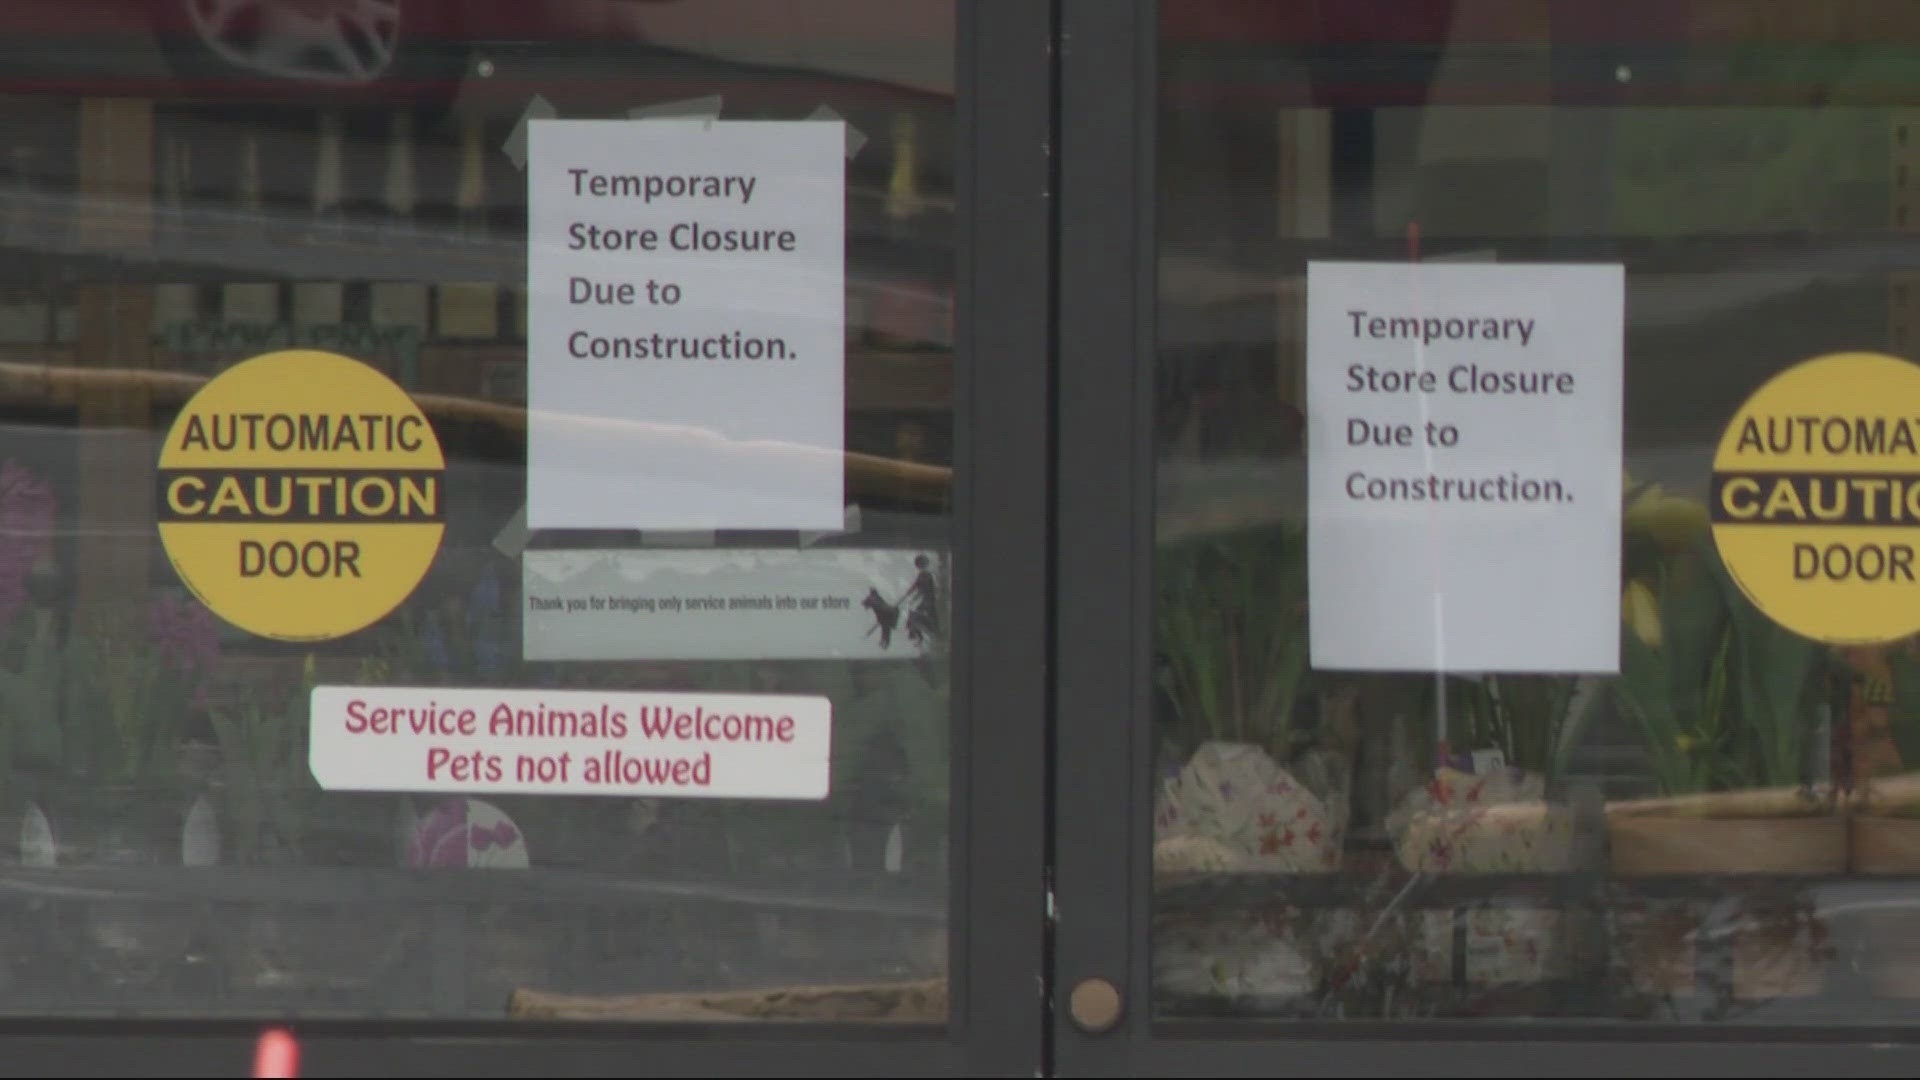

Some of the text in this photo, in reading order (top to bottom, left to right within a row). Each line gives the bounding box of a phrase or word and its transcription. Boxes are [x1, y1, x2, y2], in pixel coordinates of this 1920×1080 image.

[568, 169, 756, 204] Temporary
[569, 222, 796, 251] Store Closure
[569, 277, 682, 306] Due to
[568, 331, 797, 359] Construction.
[1347, 311, 1535, 347] Temporary
[1346, 364, 1575, 393] Store Closure
[181, 413, 423, 452] AUTOMATIC
[1346, 418, 1459, 447] Due to
[1737, 416, 1920, 455] AUTOMA
[167, 476, 436, 516] CAUTION
[1346, 472, 1574, 502] Construction.
[239, 540, 362, 578] DOOR
[1793, 542, 1916, 581] DOOR
[529, 595, 850, 613] Thank you for bringing only service animals into our store
[345, 700, 795, 742] Service Animals Welcome
[426, 748, 711, 785] Pets not allowed
